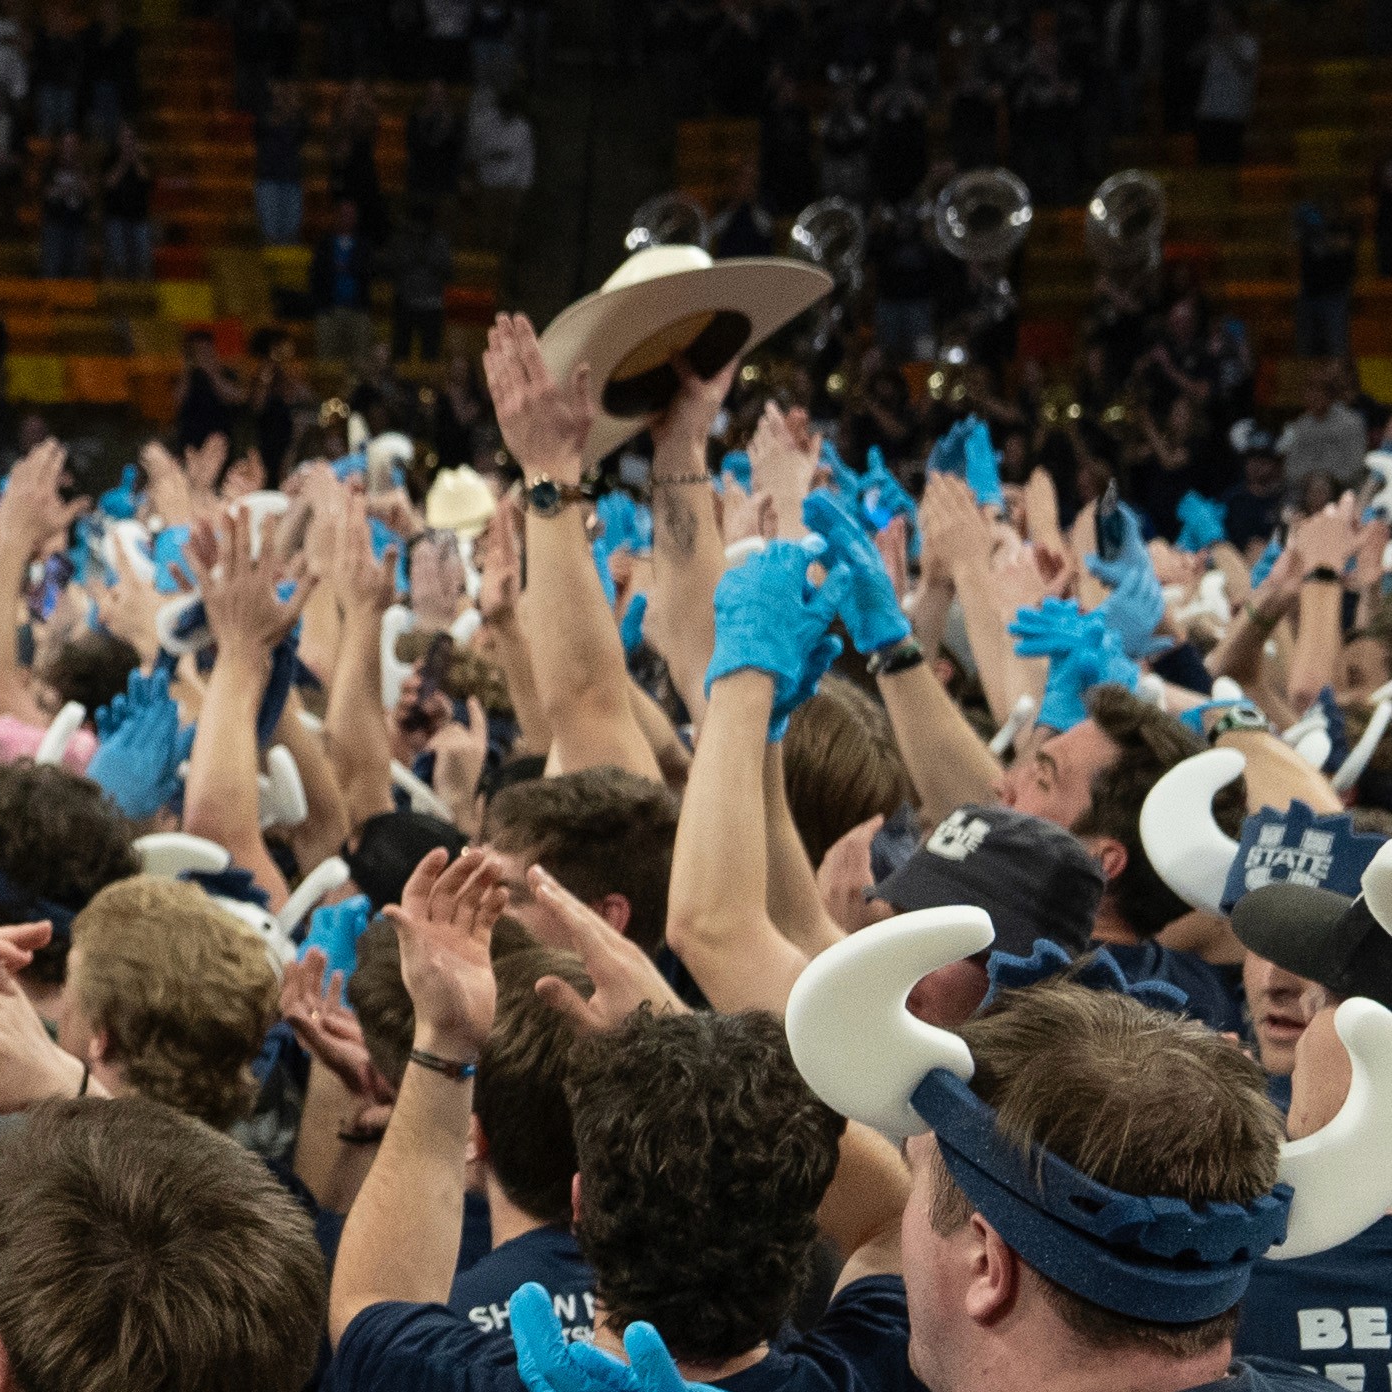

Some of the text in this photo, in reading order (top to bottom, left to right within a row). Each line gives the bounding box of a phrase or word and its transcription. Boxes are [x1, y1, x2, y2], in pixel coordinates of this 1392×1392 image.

[1245, 845, 1333, 880] STATE
[468, 1293, 577, 1333] SHW
[1297, 1306, 1392, 1350] BE
